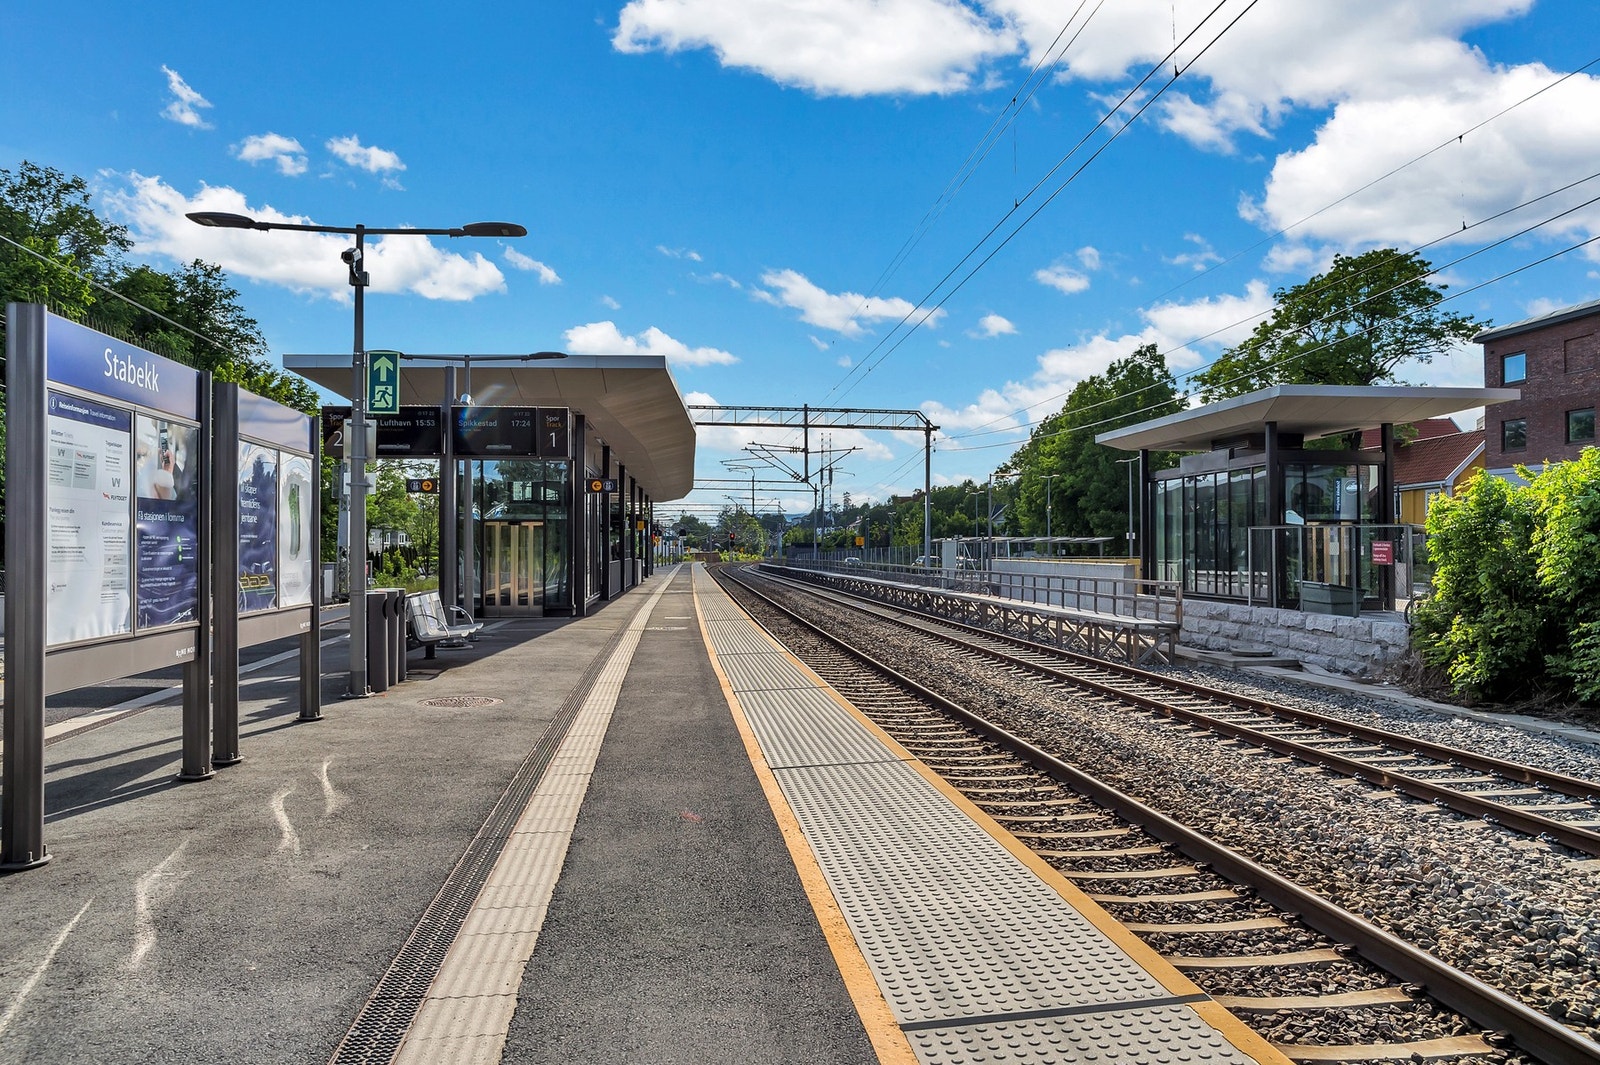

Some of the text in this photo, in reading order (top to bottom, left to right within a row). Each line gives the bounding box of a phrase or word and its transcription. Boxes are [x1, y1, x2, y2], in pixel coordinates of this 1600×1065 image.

[104, 348, 159, 392] Stabekk
[329, 413, 344, 421] Spor
[379, 419, 436, 427] Lufthavn 15:53
[458, 420, 498, 428] Spikkestad
[333, 430, 344, 447] 2
[549, 432, 556, 448] 1
[143, 511, 165, 523] stasjonen
[168, 512, 185, 522] lomma
